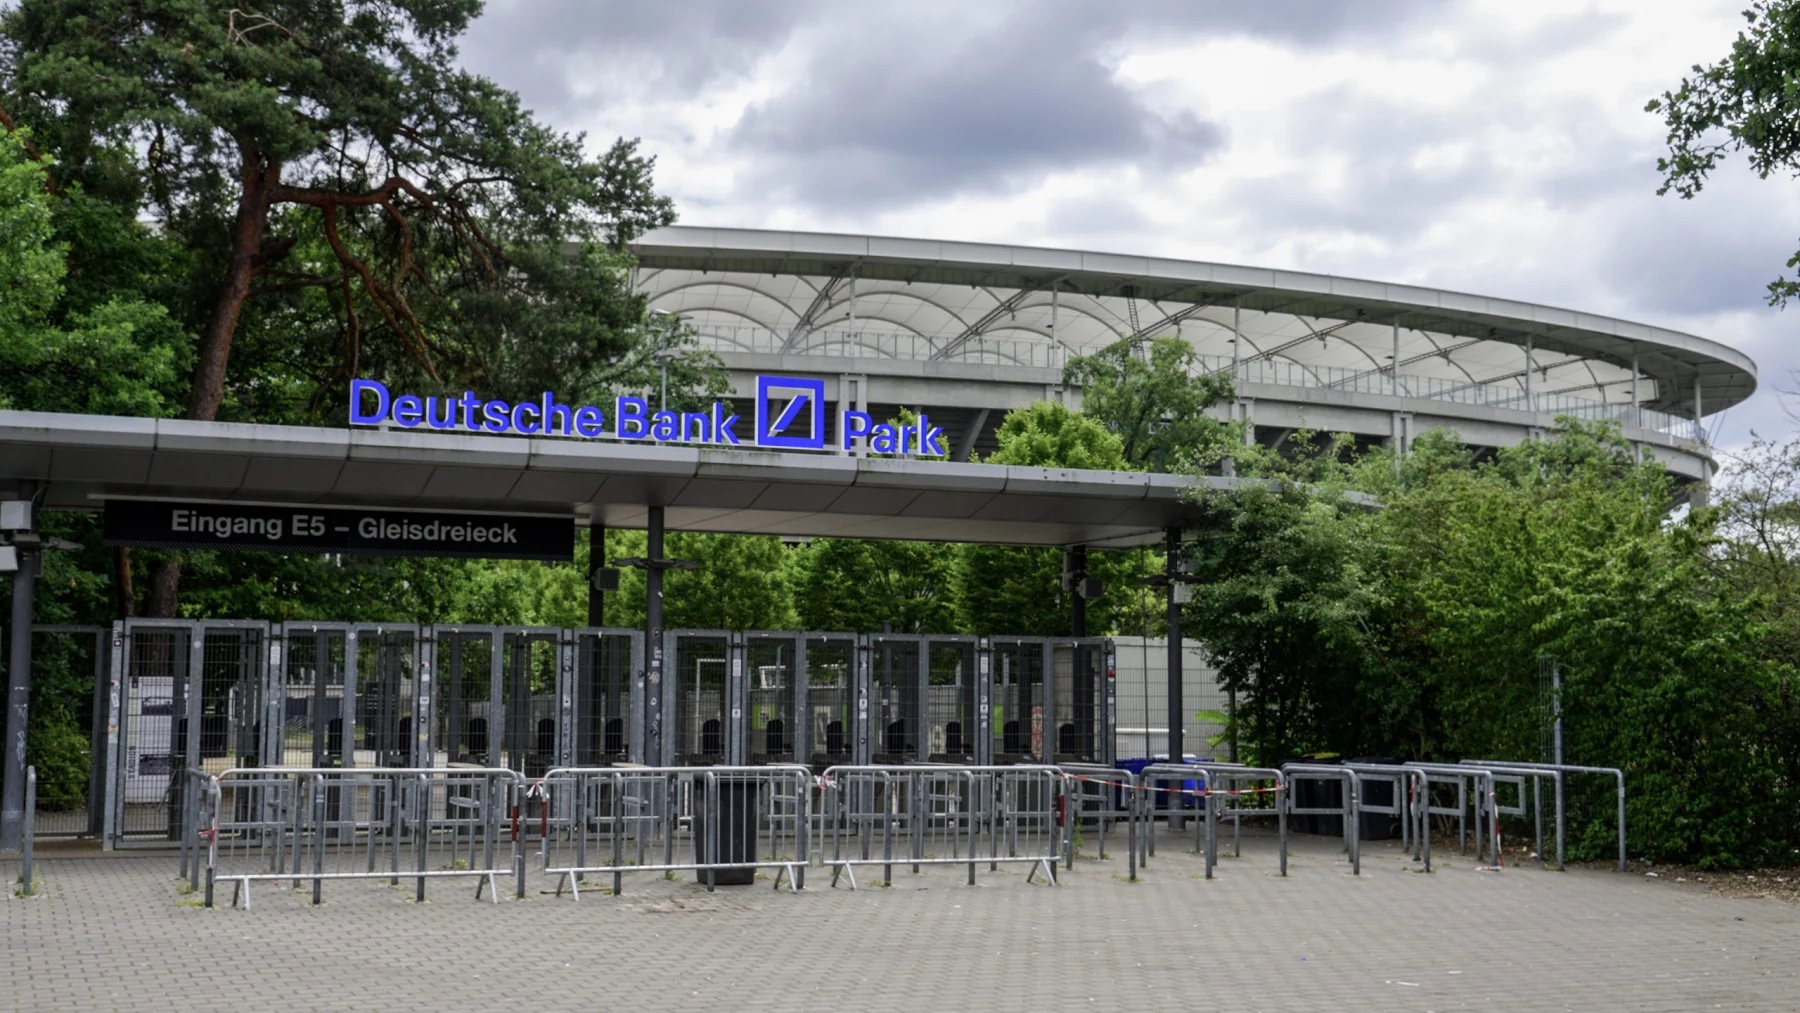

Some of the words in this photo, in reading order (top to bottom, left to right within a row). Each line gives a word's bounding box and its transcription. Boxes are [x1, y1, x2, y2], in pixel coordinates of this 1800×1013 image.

[349, 378, 603, 438] Deutsche
[615, 395, 740, 445] Bank
[841, 410, 945, 457] Park
[171, 509, 282, 540] Eingang
[292, 515, 325, 536] E5
[358, 517, 517, 543] Gleisdreieck
